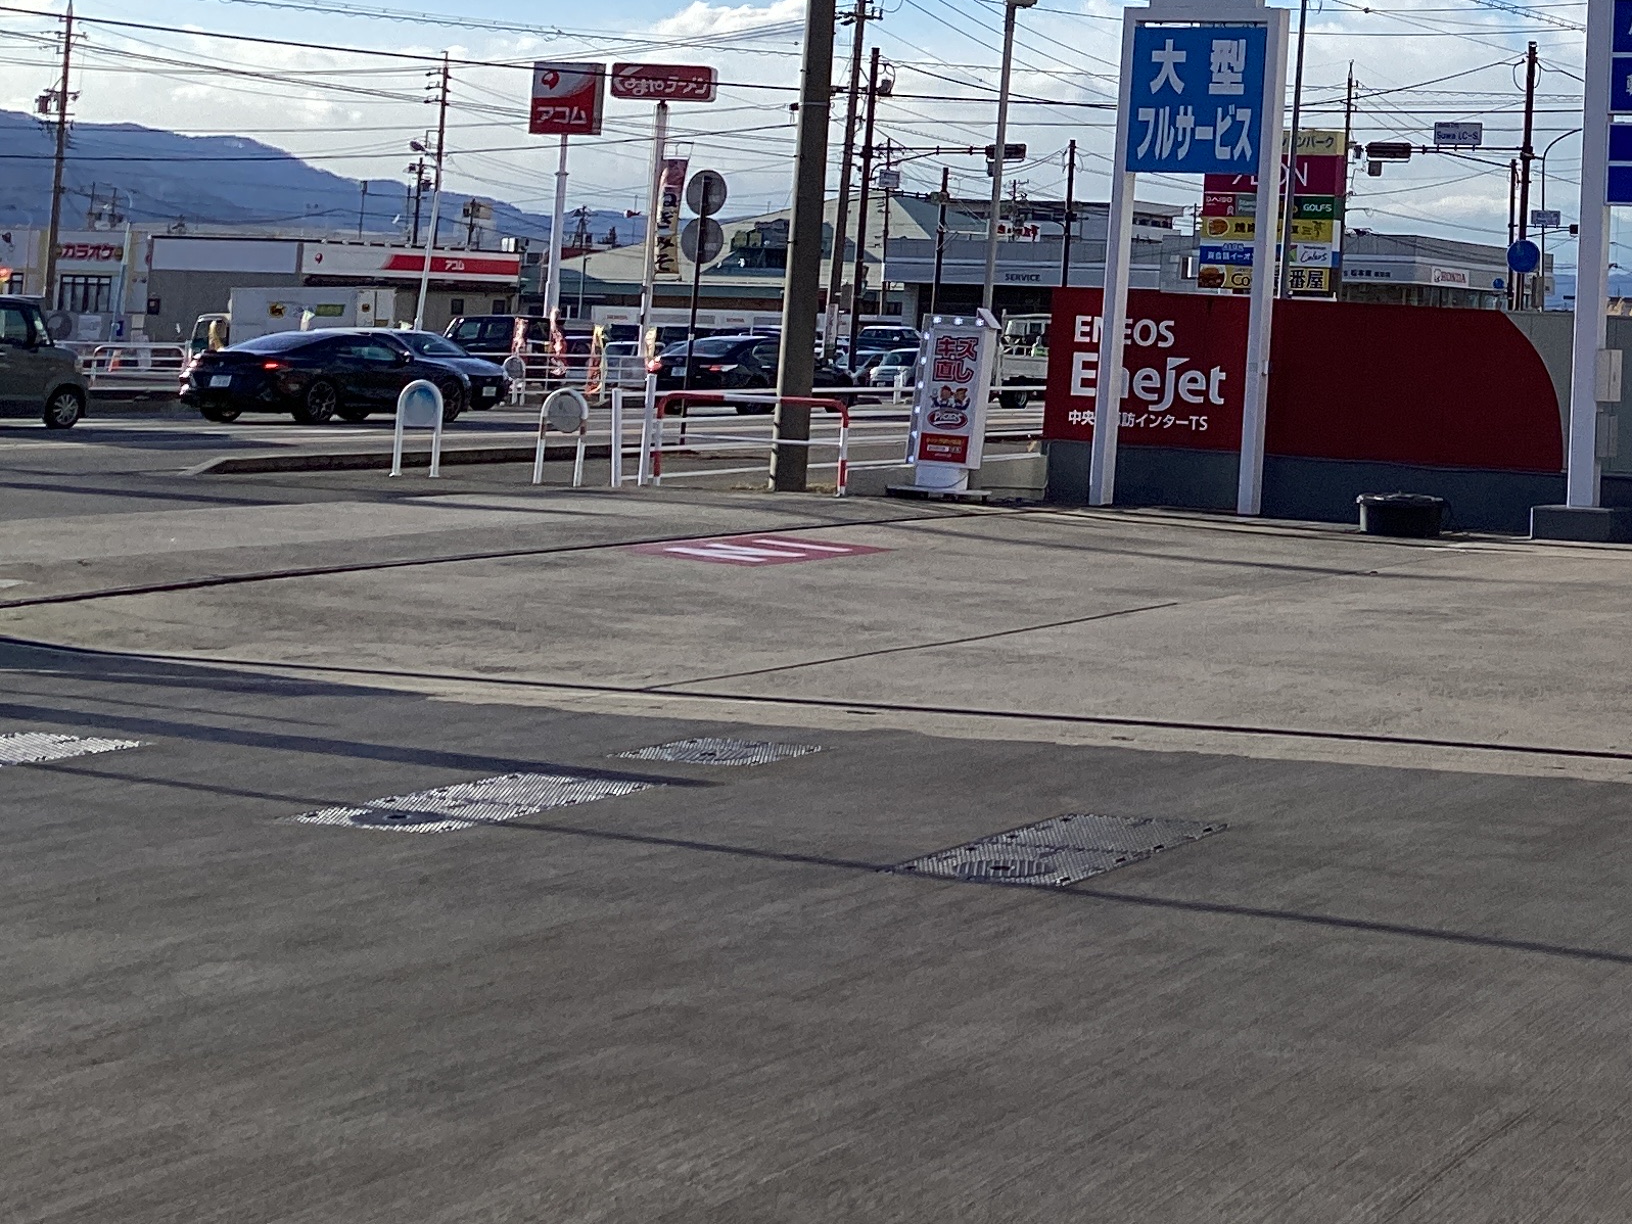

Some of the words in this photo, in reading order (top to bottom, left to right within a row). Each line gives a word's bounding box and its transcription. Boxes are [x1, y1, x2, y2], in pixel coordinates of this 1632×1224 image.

[536, 105, 588, 125] アコム
[1136, 103, 1253, 162] フルサービス
[61, 243, 116, 261] カラオケ
[1005, 272, 1041, 282] SERVICE
[1441, 271, 1467, 284] HONDA
[936, 336, 979, 361] キズ
[932, 358, 974, 384] 直し
